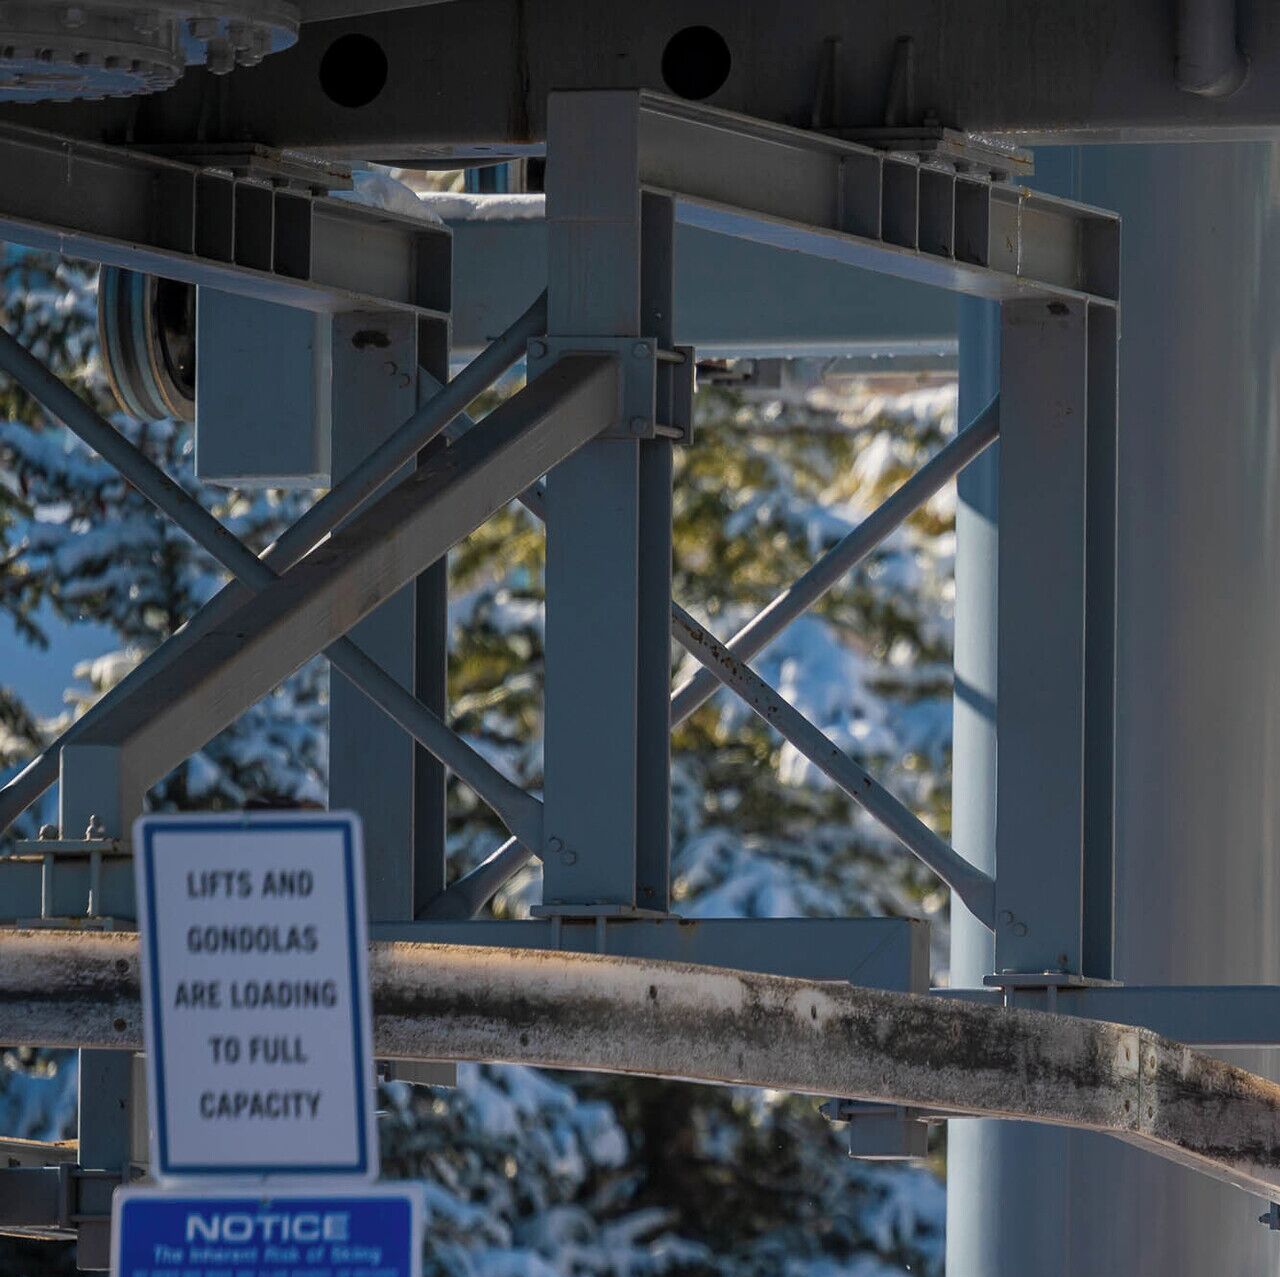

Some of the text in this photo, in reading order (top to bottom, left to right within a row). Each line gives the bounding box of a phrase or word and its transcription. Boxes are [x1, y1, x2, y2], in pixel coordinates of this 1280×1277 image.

[187, 870, 314, 898] LIFTS AND
[188, 926, 318, 954] GONDOLAS
[175, 981, 337, 1009] ARE LOADING
[209, 1036, 308, 1063] TO FULL
[200, 1091, 323, 1120] CAPACITY
[186, 1213, 350, 1242] NOTICE
